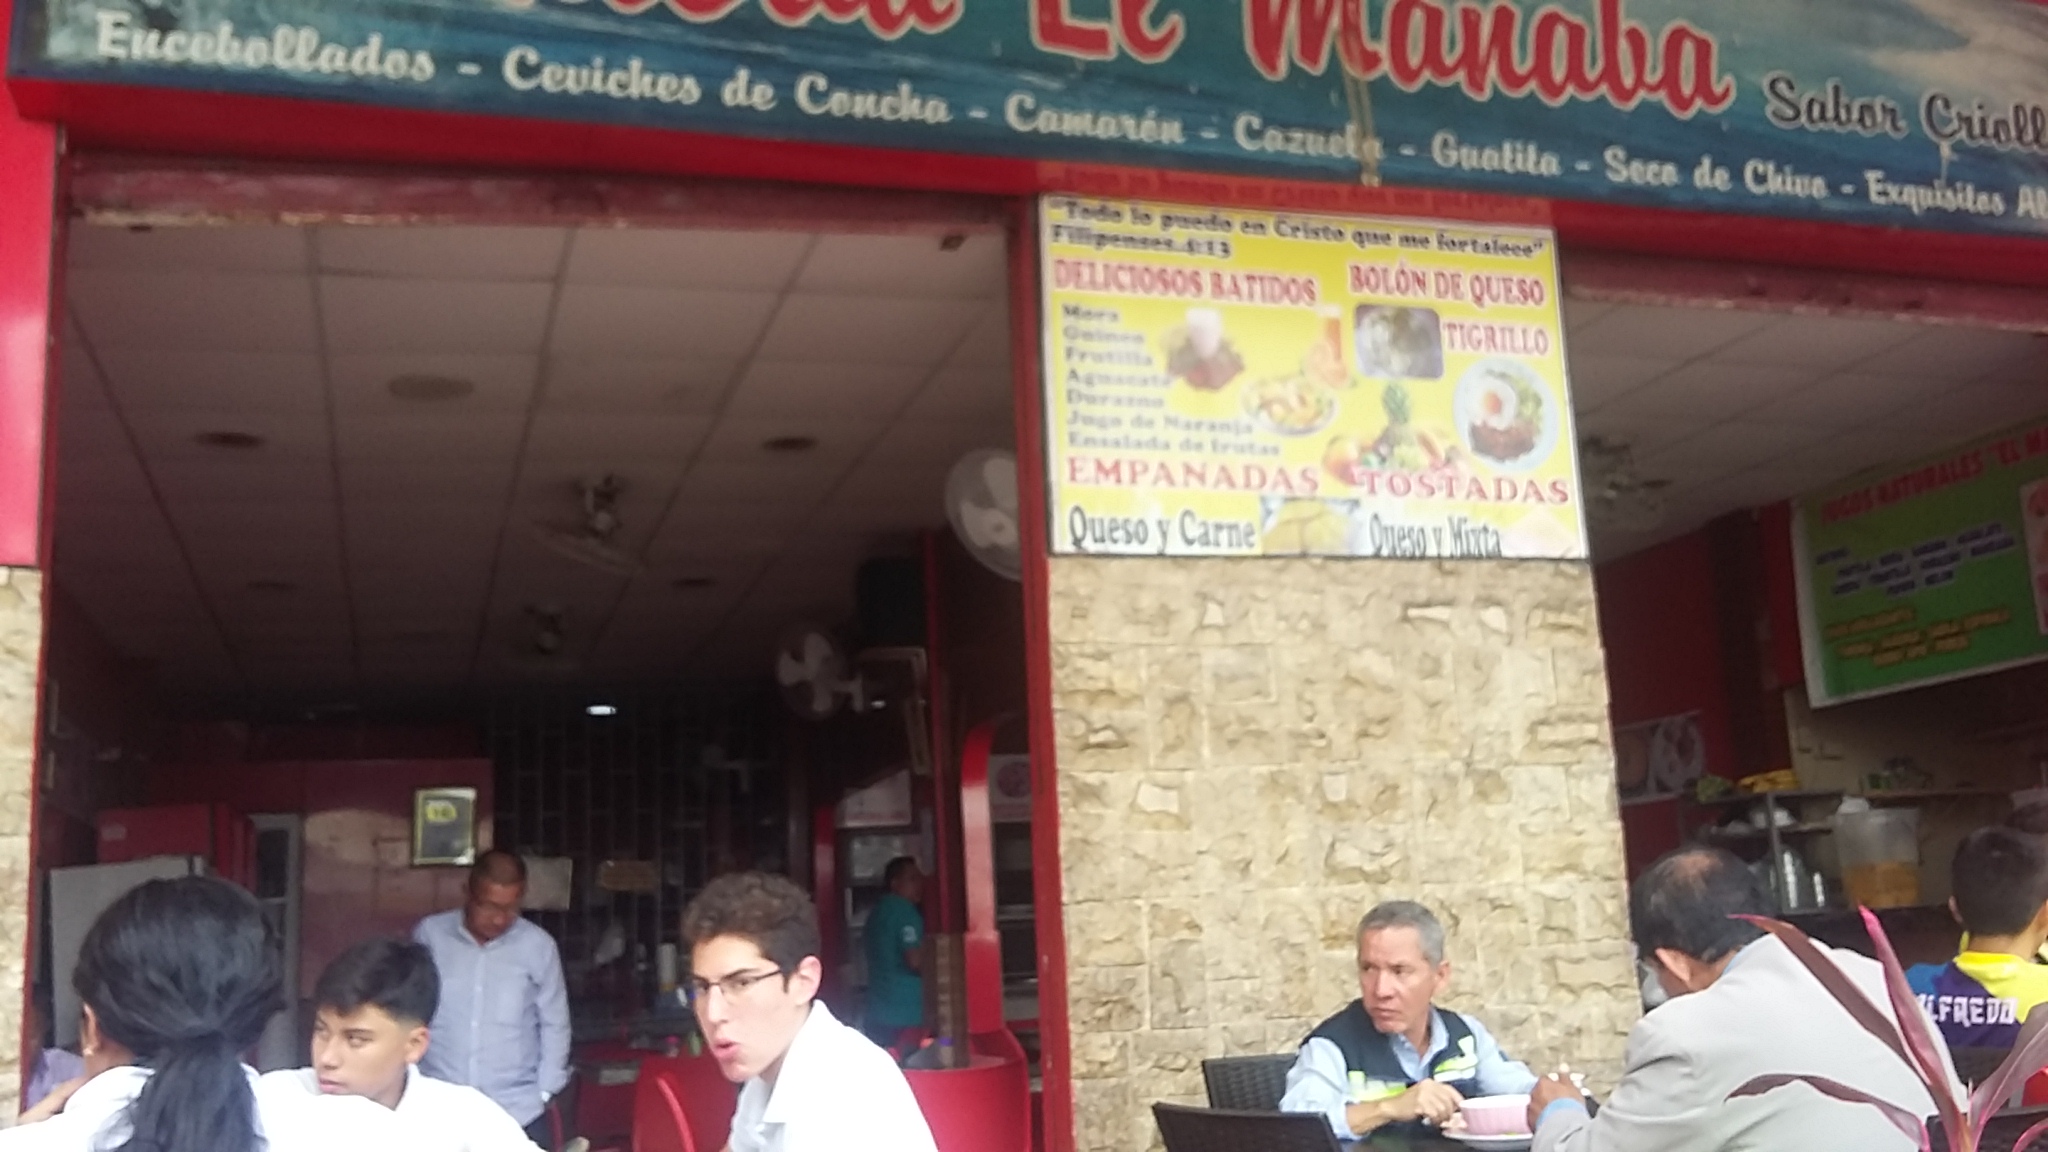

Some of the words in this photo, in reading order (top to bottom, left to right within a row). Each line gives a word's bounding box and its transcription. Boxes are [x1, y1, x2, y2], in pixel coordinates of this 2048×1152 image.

[96, 10, 434, 81] Encebollados
[503, 44, 700, 104] Ceviches
[720, 65, 777, 111] de
[794, 72, 953, 123] Concha
[1005, 92, 1186, 144] Camarón
[1431, 131, 1562, 177] Guatita
[1693, 155, 1731, 192] de
[1766, 74, 1905, 137] Sabor
[1923, 91, 2048, 150] Crioll
[1130, 204, 1152, 225] lo
[1161, 213, 1232, 233] puedo
[1241, 219, 1268, 234] en
[1275, 214, 1346, 242] Cristo
[1352, 228, 1392, 249] que
[1400, 233, 1431, 249] me
[1055, 258, 1204, 298] DELICIOSOS
[1210, 270, 1317, 306] BATIDOS
[1350, 258, 1427, 295] BOLÓN
[1434, 271, 1465, 299] DE
[1470, 274, 1545, 308] QUESO
[1063, 304, 1120, 322] Mora
[1445, 322, 1549, 355] TIGRILLO
[1130, 415, 1155, 430] de
[1179, 437, 1204, 452] de
[1068, 457, 1319, 494] EMPANADAS
[1362, 471, 1569, 504] TOSTADAS
[1069, 505, 1150, 551] Queso
[1157, 518, 1170, 555] y
[1179, 509, 1256, 549] Carne
